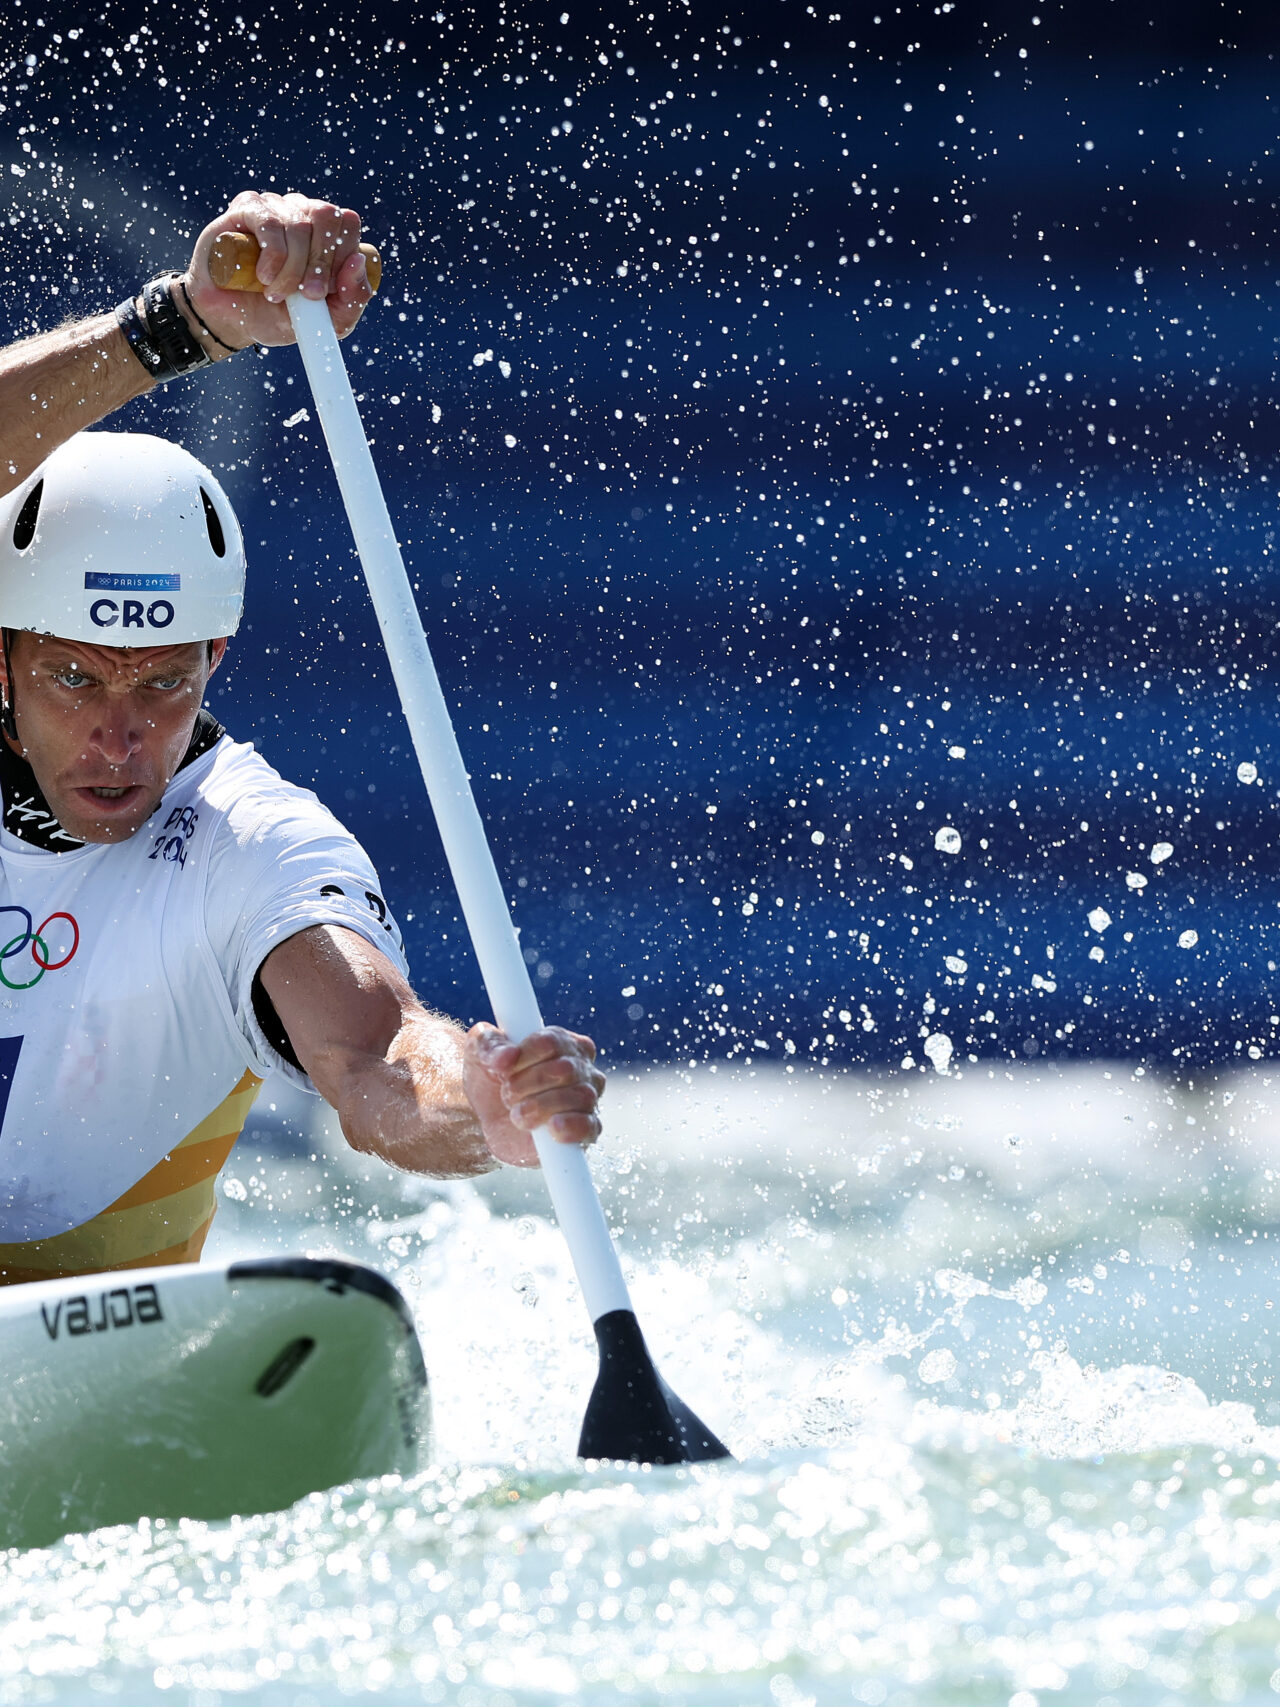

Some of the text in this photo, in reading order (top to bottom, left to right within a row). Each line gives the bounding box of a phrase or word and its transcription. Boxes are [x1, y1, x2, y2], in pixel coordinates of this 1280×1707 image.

[113, 578, 170, 587] PARIS 2024
[89, 598, 175, 629] CRO
[148, 835, 188, 871] 204
